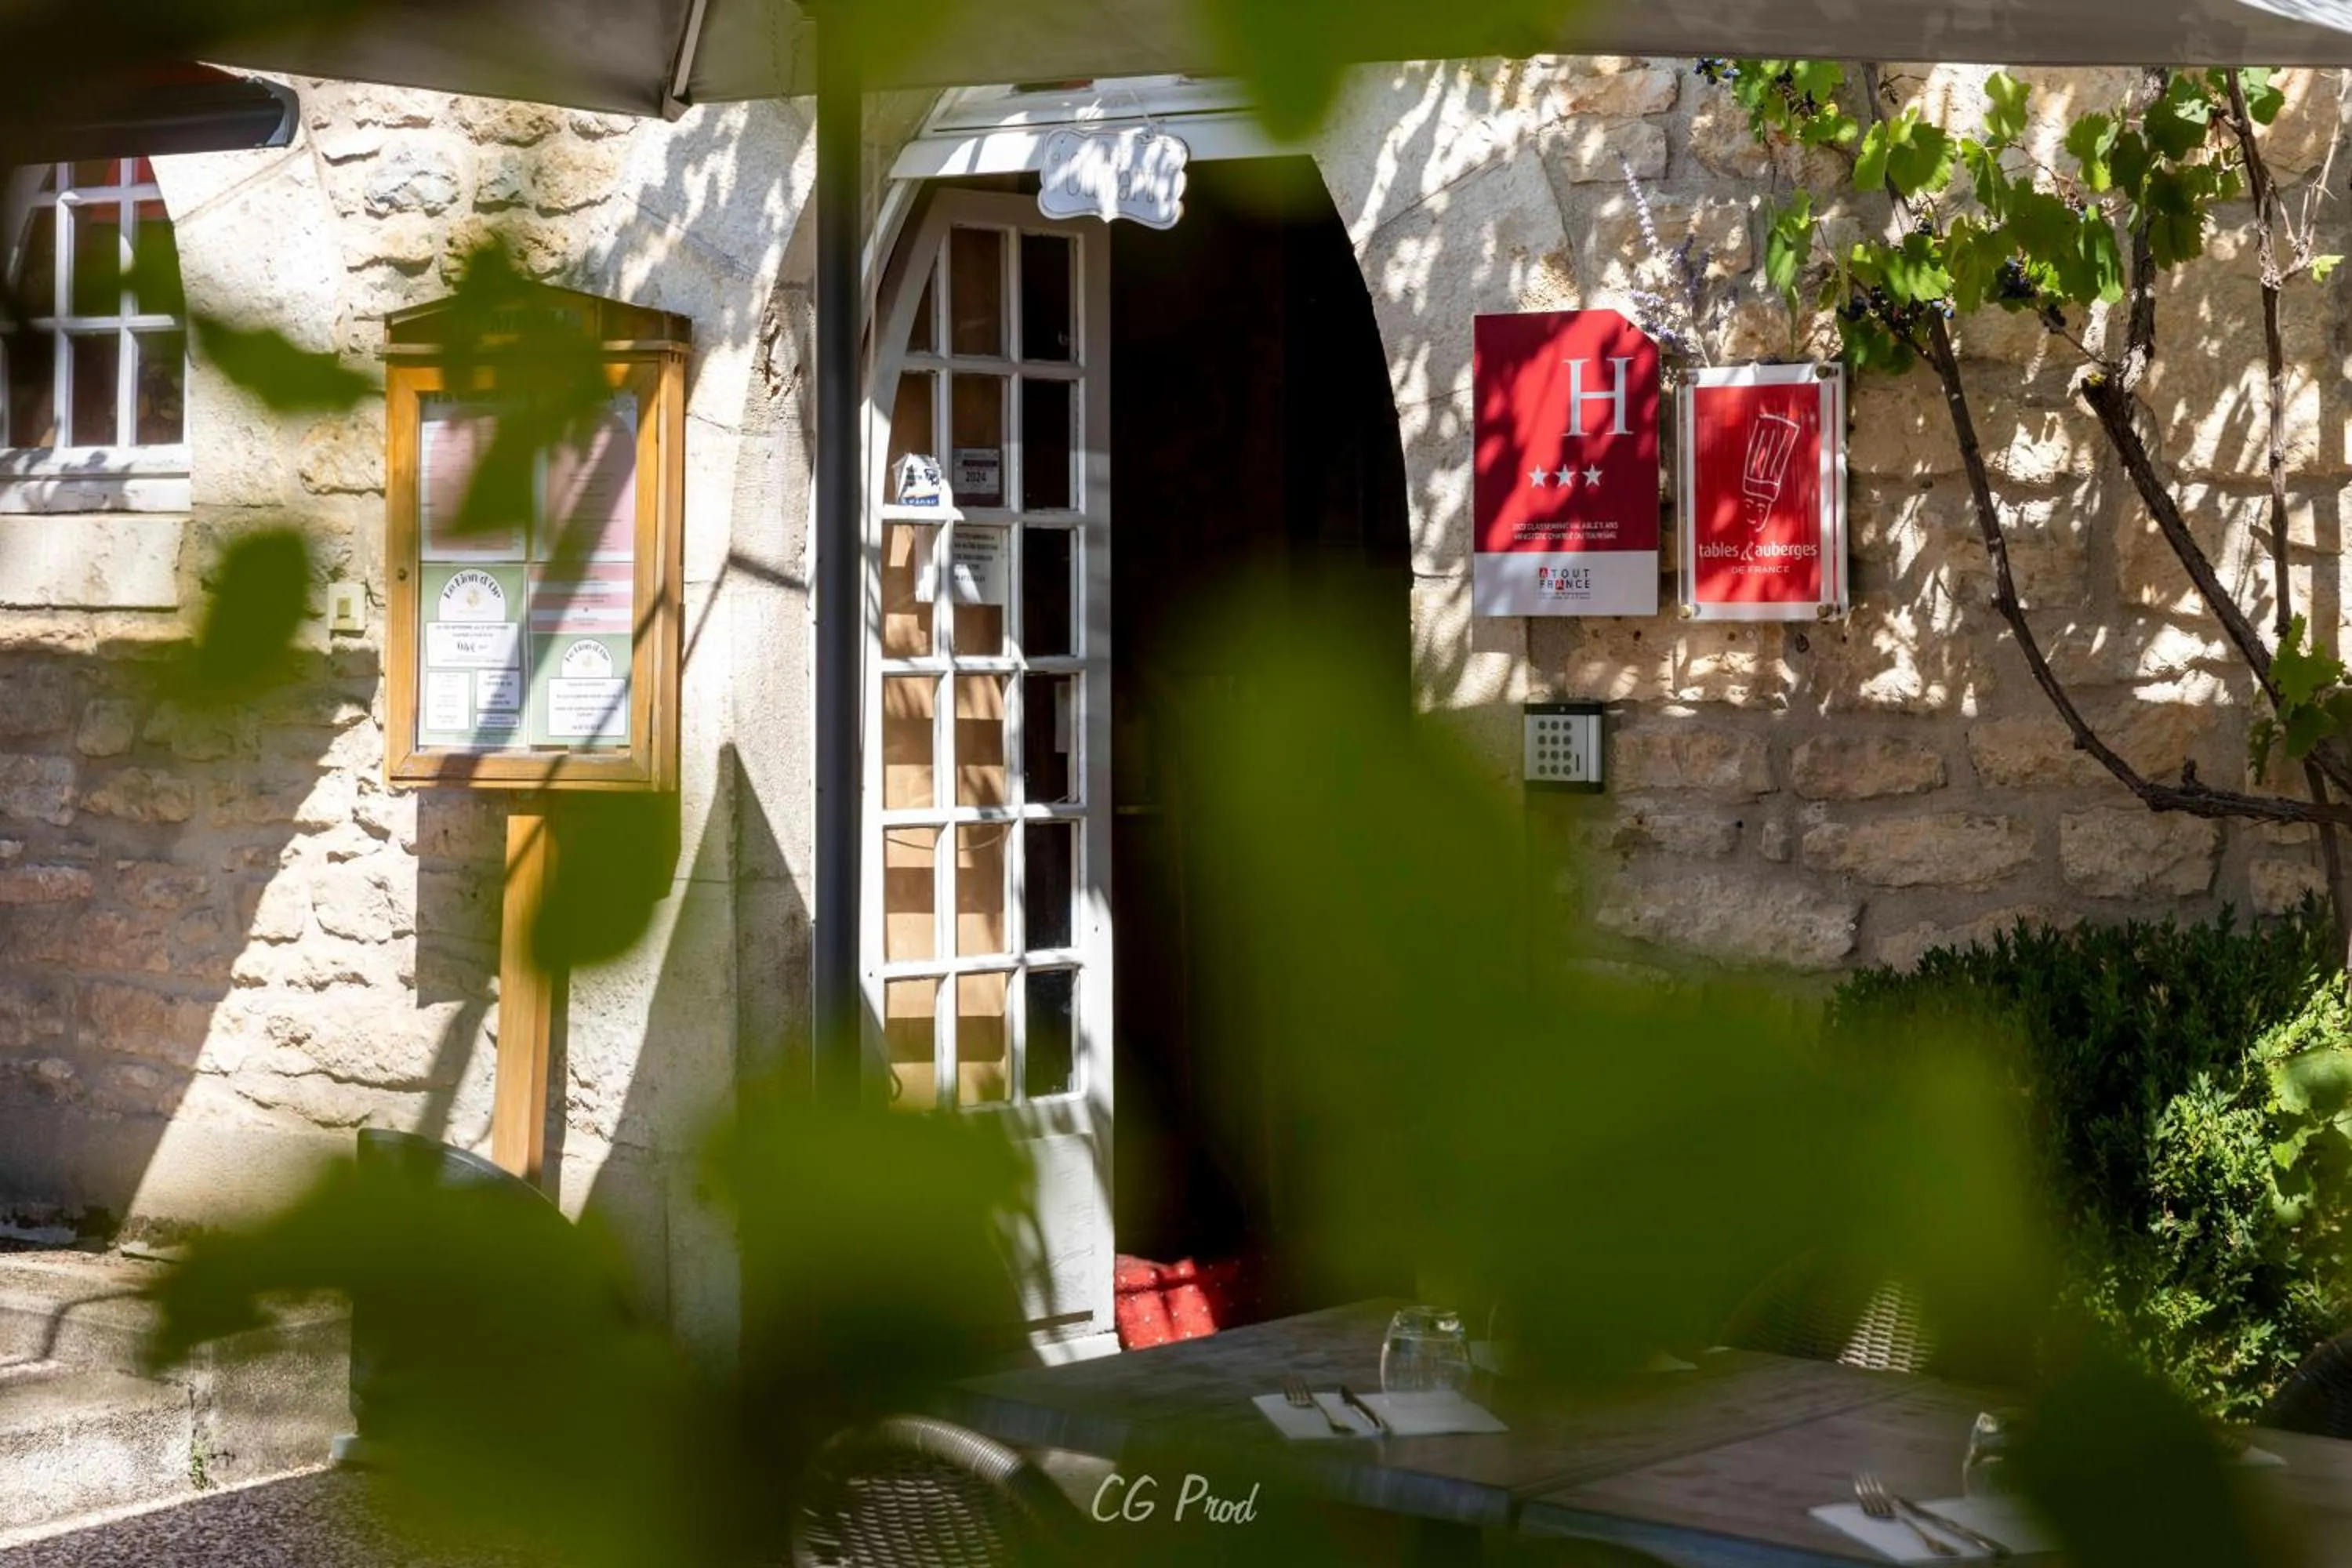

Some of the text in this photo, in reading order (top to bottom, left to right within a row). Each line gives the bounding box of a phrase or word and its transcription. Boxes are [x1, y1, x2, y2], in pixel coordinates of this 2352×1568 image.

[1562, 356, 1635, 437] H
[965, 471, 987, 484] 2024
[1698, 541, 1818, 561] tables & auberges
[1539, 568, 1591, 578] ATOUT
[1748, 565, 1791, 574] FRANCE
[1539, 579, 1591, 590] FRANCE
